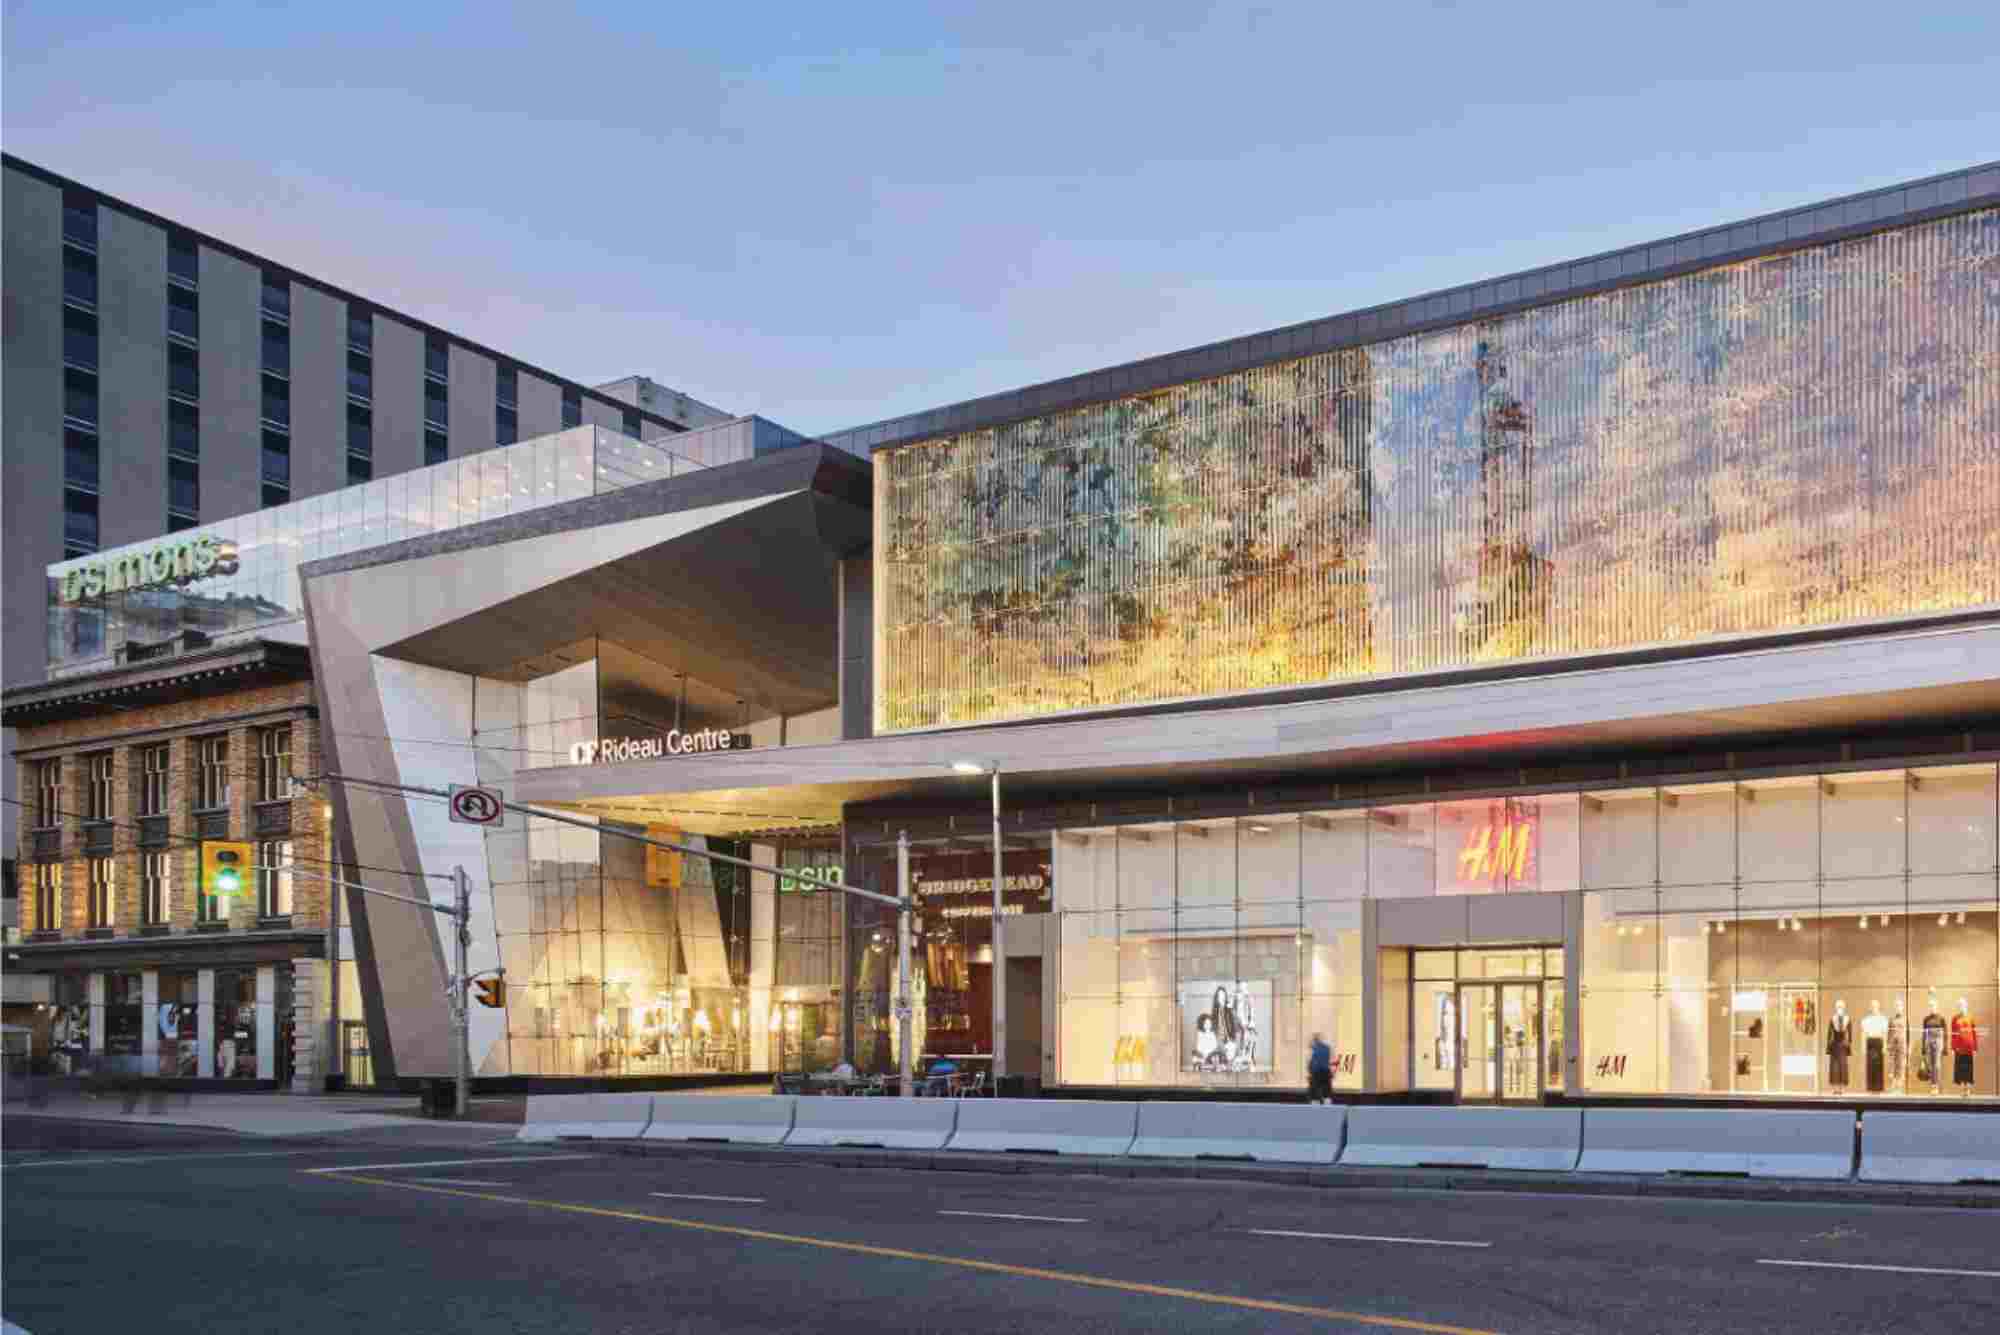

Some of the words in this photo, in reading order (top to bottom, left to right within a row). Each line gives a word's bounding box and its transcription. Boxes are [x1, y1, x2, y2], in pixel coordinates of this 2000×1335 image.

[601, 736, 662, 764] Rideau
[666, 727, 731, 754] Centre
[1459, 822, 1531, 882] HM
[917, 875, 1044, 896] BRIDGEEAD
